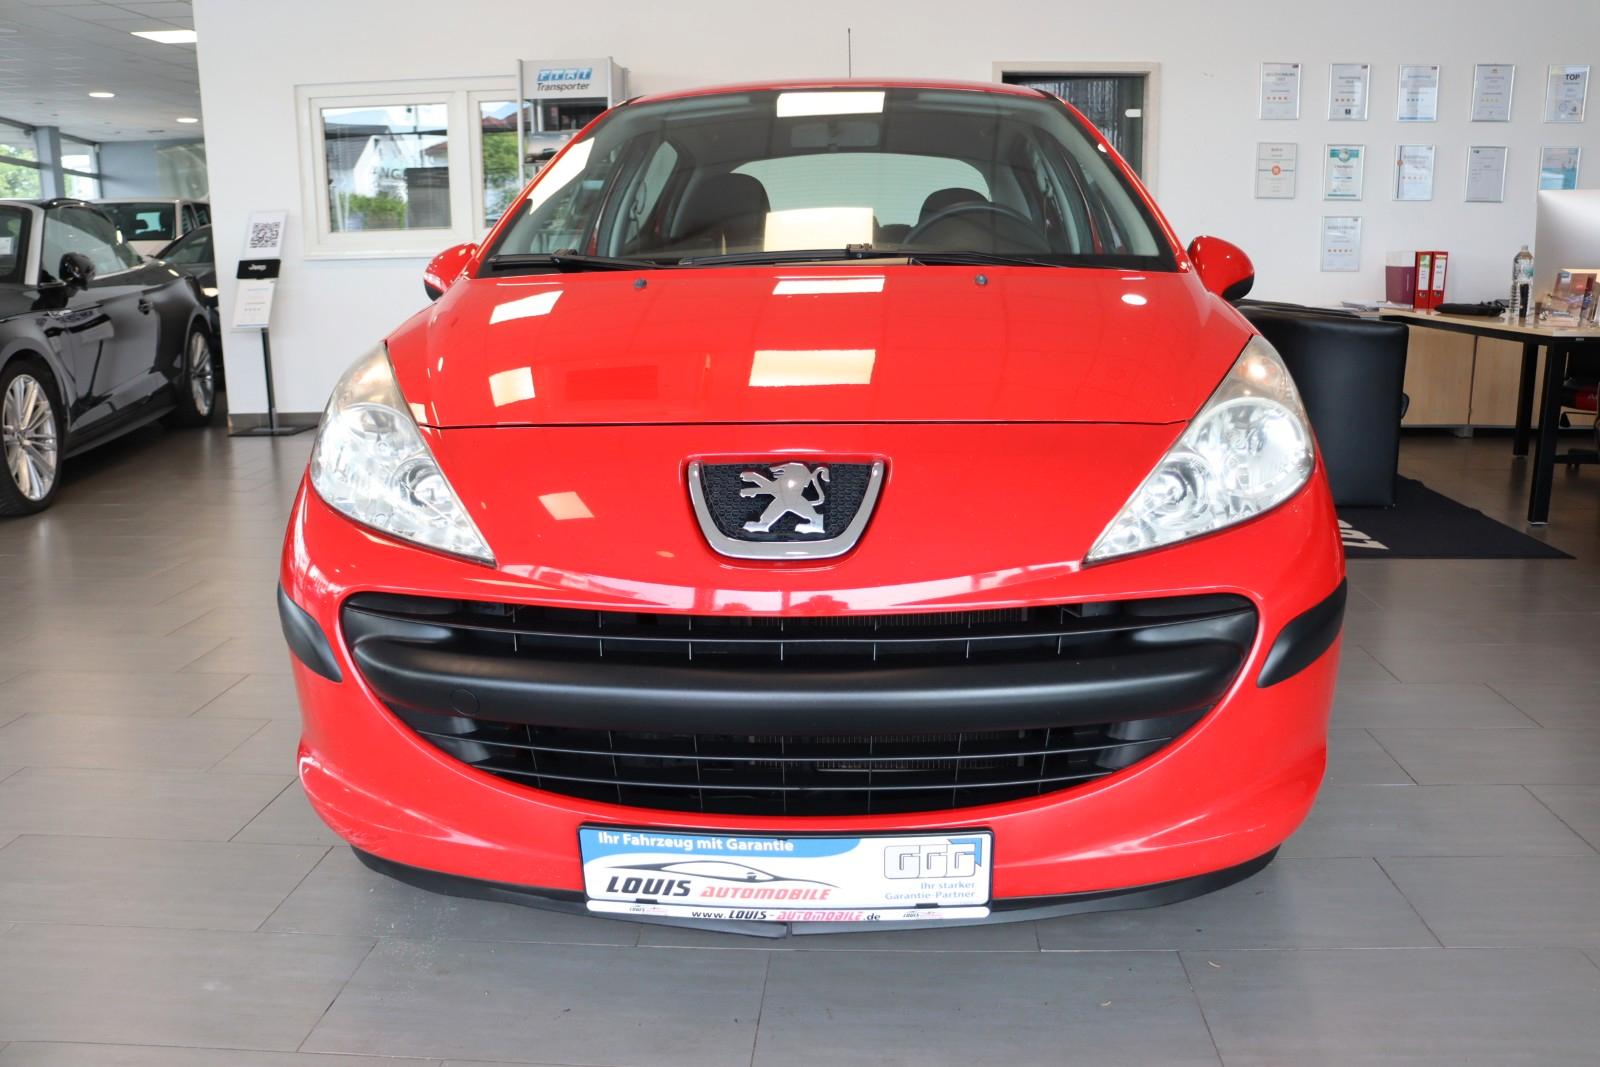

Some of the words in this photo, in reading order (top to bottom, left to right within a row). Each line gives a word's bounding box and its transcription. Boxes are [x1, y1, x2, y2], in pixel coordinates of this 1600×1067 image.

[1565, 73, 1581, 81] TOP
[537, 82, 591, 92] Transporter
[598, 831, 620, 845] Ihr
[623, 833, 694, 851] Fahrzeug
[697, 838, 723, 850] mit
[726, 838, 794, 852] Garantie
[606, 875, 692, 897] LOUIS
[921, 882, 936, 890] Ihr
[938, 881, 976, 890] starker
[885, 890, 976, 901] Garantie-Partner
